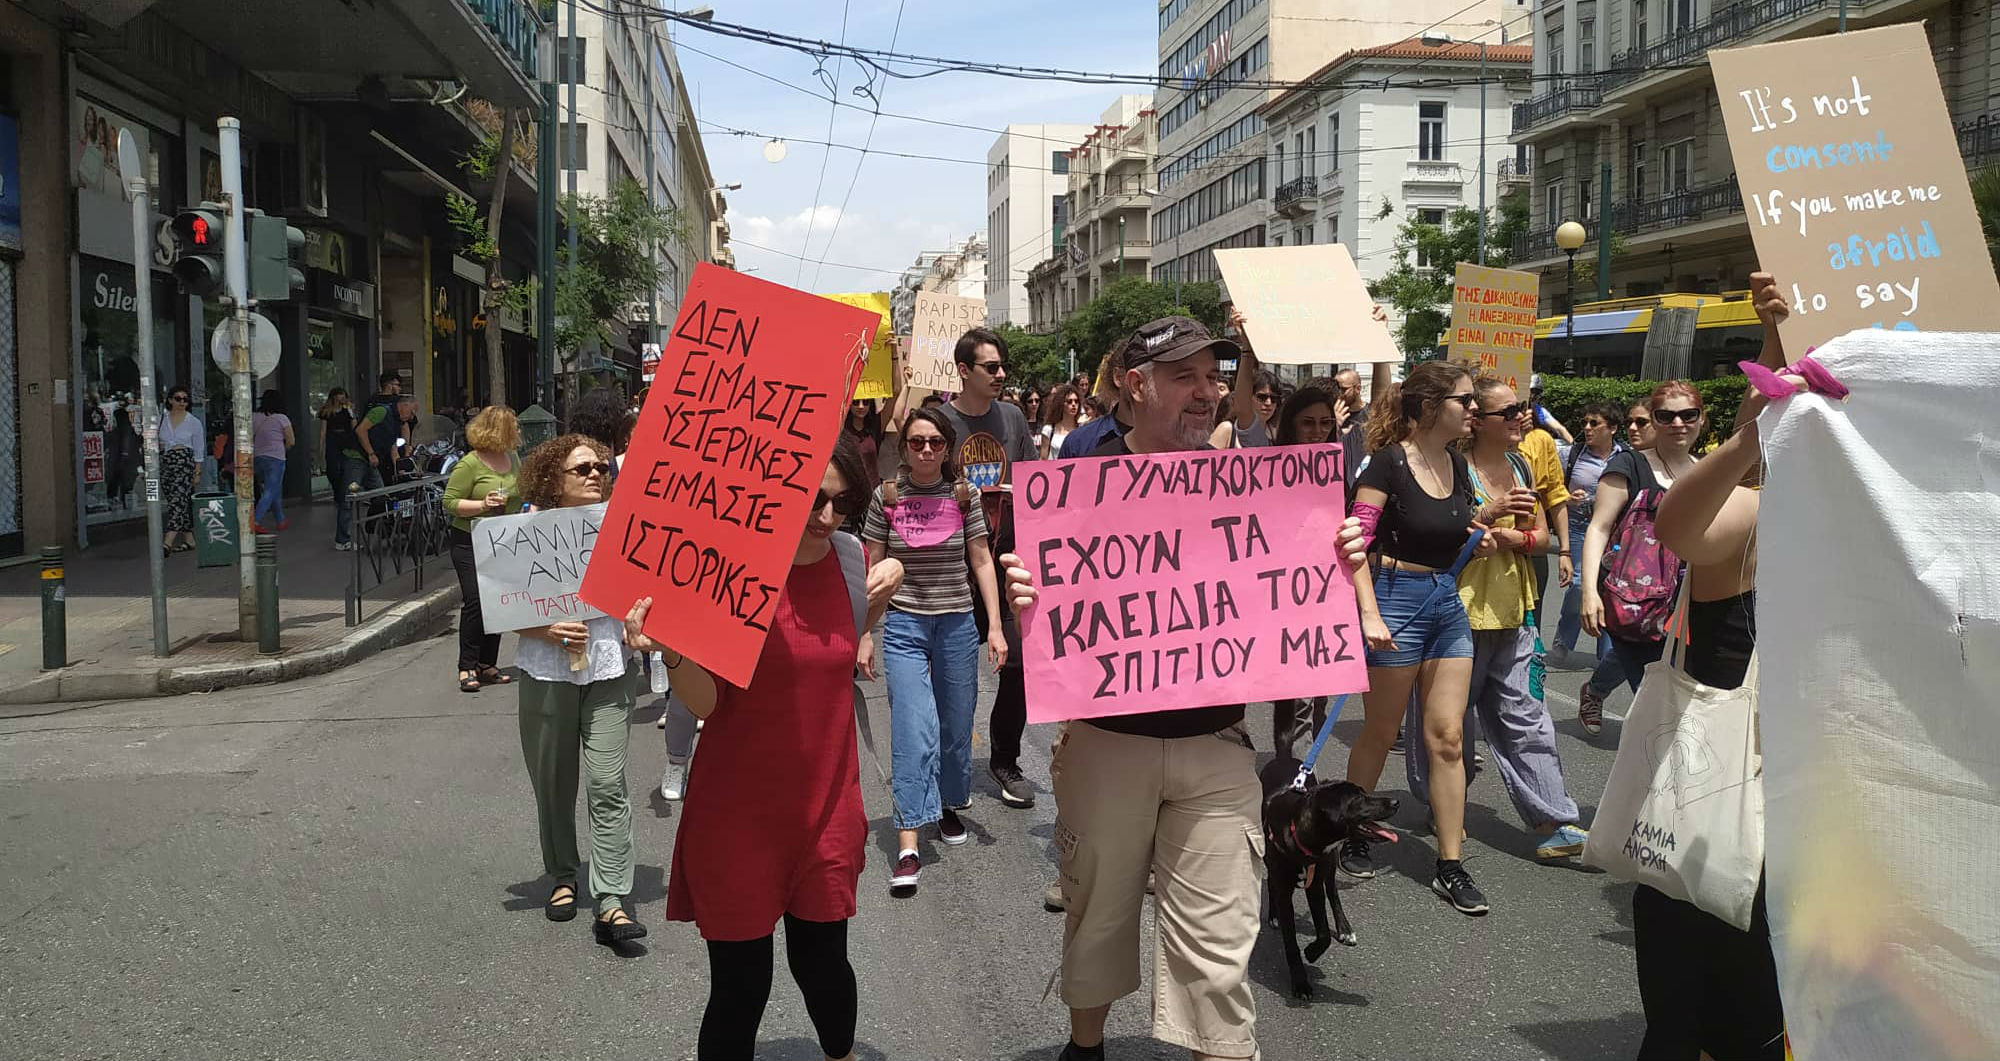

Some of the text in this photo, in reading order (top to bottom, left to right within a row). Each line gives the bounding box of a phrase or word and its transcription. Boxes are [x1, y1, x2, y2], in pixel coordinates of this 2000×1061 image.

[1738, 76, 1871, 133] It's not
[1765, 128, 1893, 174] consent
[1752, 185, 1942, 237] If you make me
[1827, 217, 1941, 270] afraid
[919, 299, 985, 321] RAPISTS
[1457, 286, 1480, 304] ΤΗΣ
[1468, 309, 1476, 323] Η
[1792, 276, 1920, 316] to say
[676, 300, 759, 357] ΔΕΝ
[928, 321, 968, 338] RAPE
[1457, 328, 1532, 351] ΕΙΝΑΙ ΑΠΑΤΗ
[673, 351, 827, 441] ΕΙΜΑΣΤΕ
[664, 403, 813, 494] ΥΣΤΕΡΙΚΕΣ
[963, 439, 1000, 464] BAYERN
[644, 461, 783, 534] ΕΙΜΑΣΤΕ
[1026, 449, 1344, 510] ΟΙ ΓΥΝΑΙΚΟΚΤΟΝΟΙ
[896, 512, 937, 525] MEANS
[905, 501, 922, 510] NO
[488, 518, 599, 558] ΚΑΜΙΑ
[906, 527, 925, 538] NO
[1038, 514, 1270, 587] ΕΧΟΥΝ ΤΑ
[621, 513, 779, 632] ΙΣΤΟΡΙΚΕΣ
[1047, 563, 1337, 660] ΚΛΕΙΔΙΑ ΤΟΥ
[1093, 623, 1355, 700] ΣΠΙΤΙΟΥ ΜΑΣ
[1622, 837, 1667, 872] ΑΝΟΧΗ
[1631, 819, 1676, 851] ΚΑΜΙΑ
